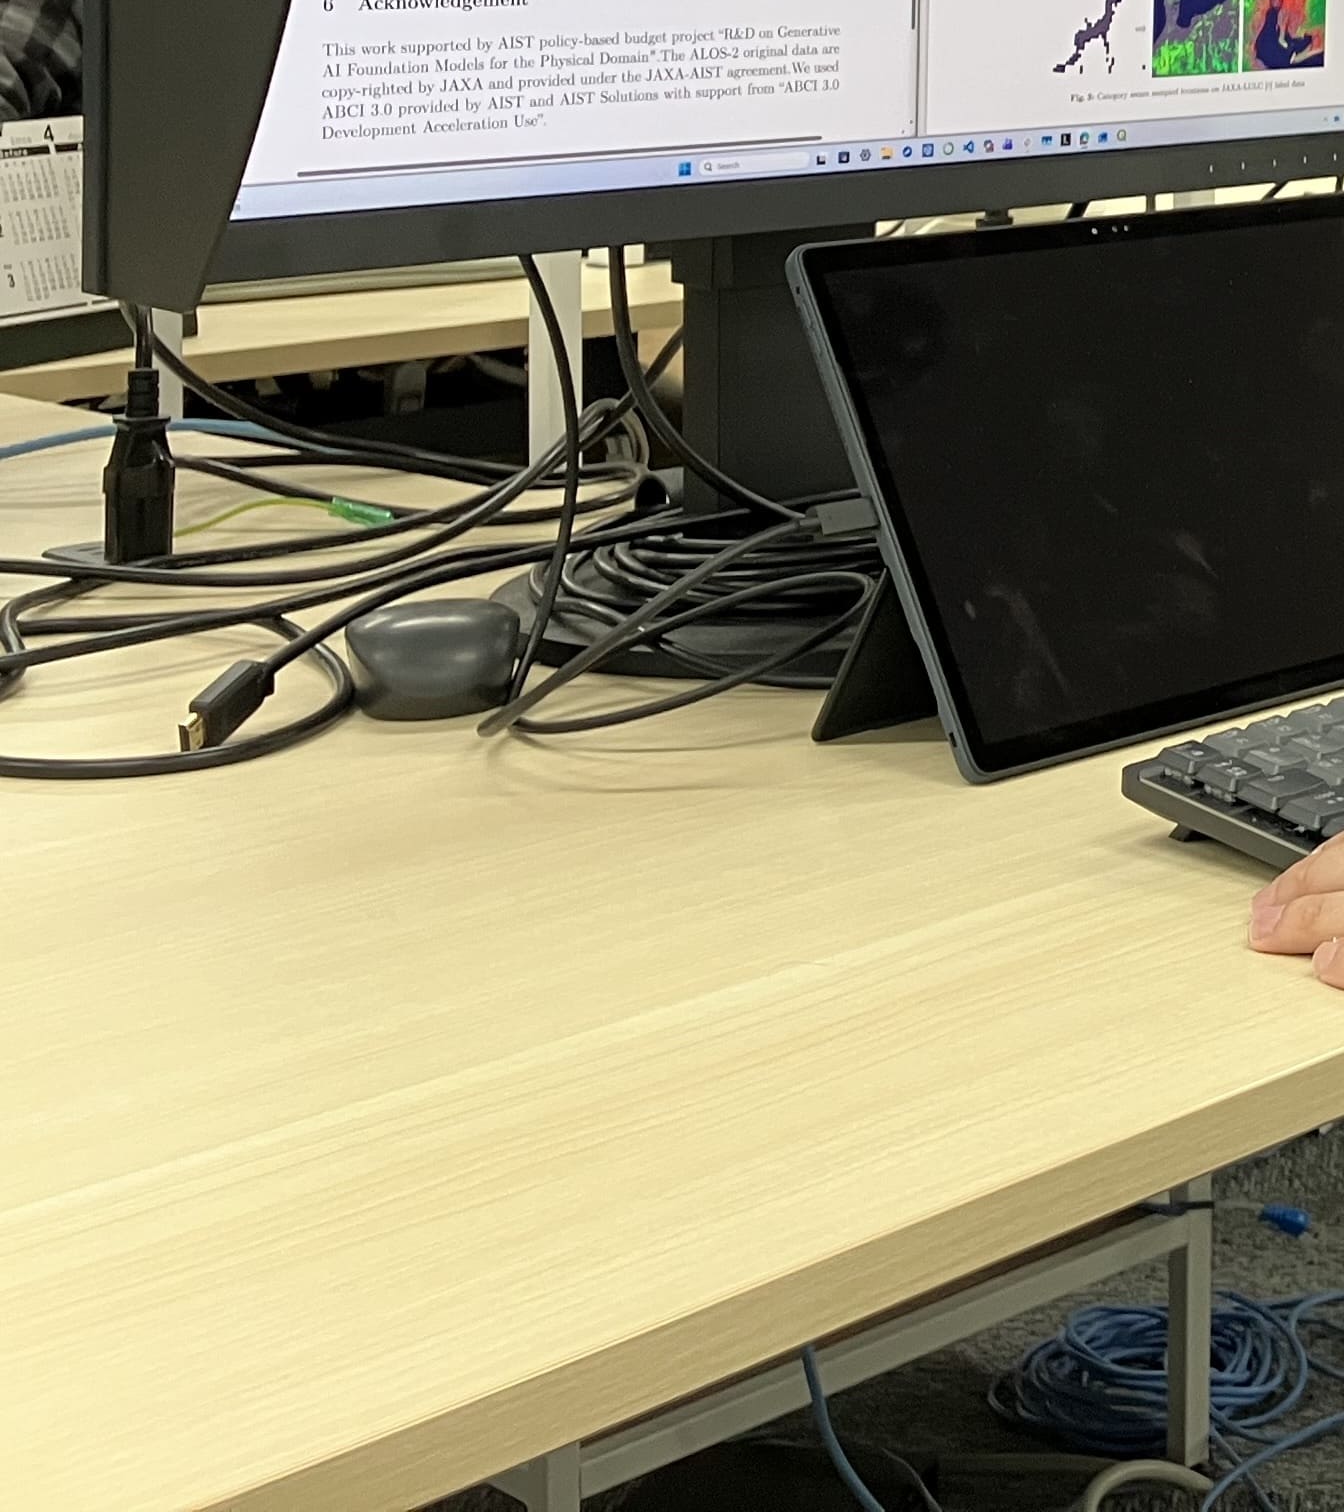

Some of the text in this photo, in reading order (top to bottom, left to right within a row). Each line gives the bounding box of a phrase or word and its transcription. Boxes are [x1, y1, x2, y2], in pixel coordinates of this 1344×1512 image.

[323, 42, 355, 57] This
[362, 40, 395, 55] work
[401, 37, 471, 57] supported
[477, 36, 492, 54] by
[498, 35, 534, 50] AIST
[539, 31, 619, 51] policy-based
[625, 31, 666, 47] budget
[672, 28, 714, 46] project
[759, 29, 772, 39] on
[778, 25, 840, 38] Generative
[323, 63, 340, 77] AI
[347, 60, 428, 76] Foundation
[435, 57, 484, 72] Models
[490, 56, 508, 70] for
[513, 54, 534, 69] the
[541, 52, 594, 71] Physical
[691, 46, 738, 61] ALOS-2
[744, 43, 787, 61] original
[792, 42, 817, 56] data
[821, 45, 839, 55] are
[322, 80, 412, 101] copy-righted
[419, 79, 435, 97] by
[440, 77, 483, 92] JAXA
[489, 75, 512, 90] and
[518, 72, 575, 92] provided
[581, 71, 616, 86] under
[622, 69, 641, 83] the
[645, 65, 723, 82] JAXA-AIST
[814, 59, 838, 73] used
[322, 103, 364, 119] ABCI
[371, 102, 392, 117] 3.0
[398, 98, 458, 119] provided
[466, 97, 480, 115] by
[488, 95, 524, 110] AIST
[530, 93, 554, 108] and
[560, 91, 595, 106] AIST
[600, 87, 658, 104] Solutions
[664, 85, 690, 100] with
[696, 84, 741, 101] support
[748, 81, 774, 95] from
[823, 78, 839, 90] 3.0
[43, 124, 54, 142] 4
[322, 122, 416, 141] Development
[423, 115, 508, 133] Acceleration
[717, 161, 740, 170] Search
